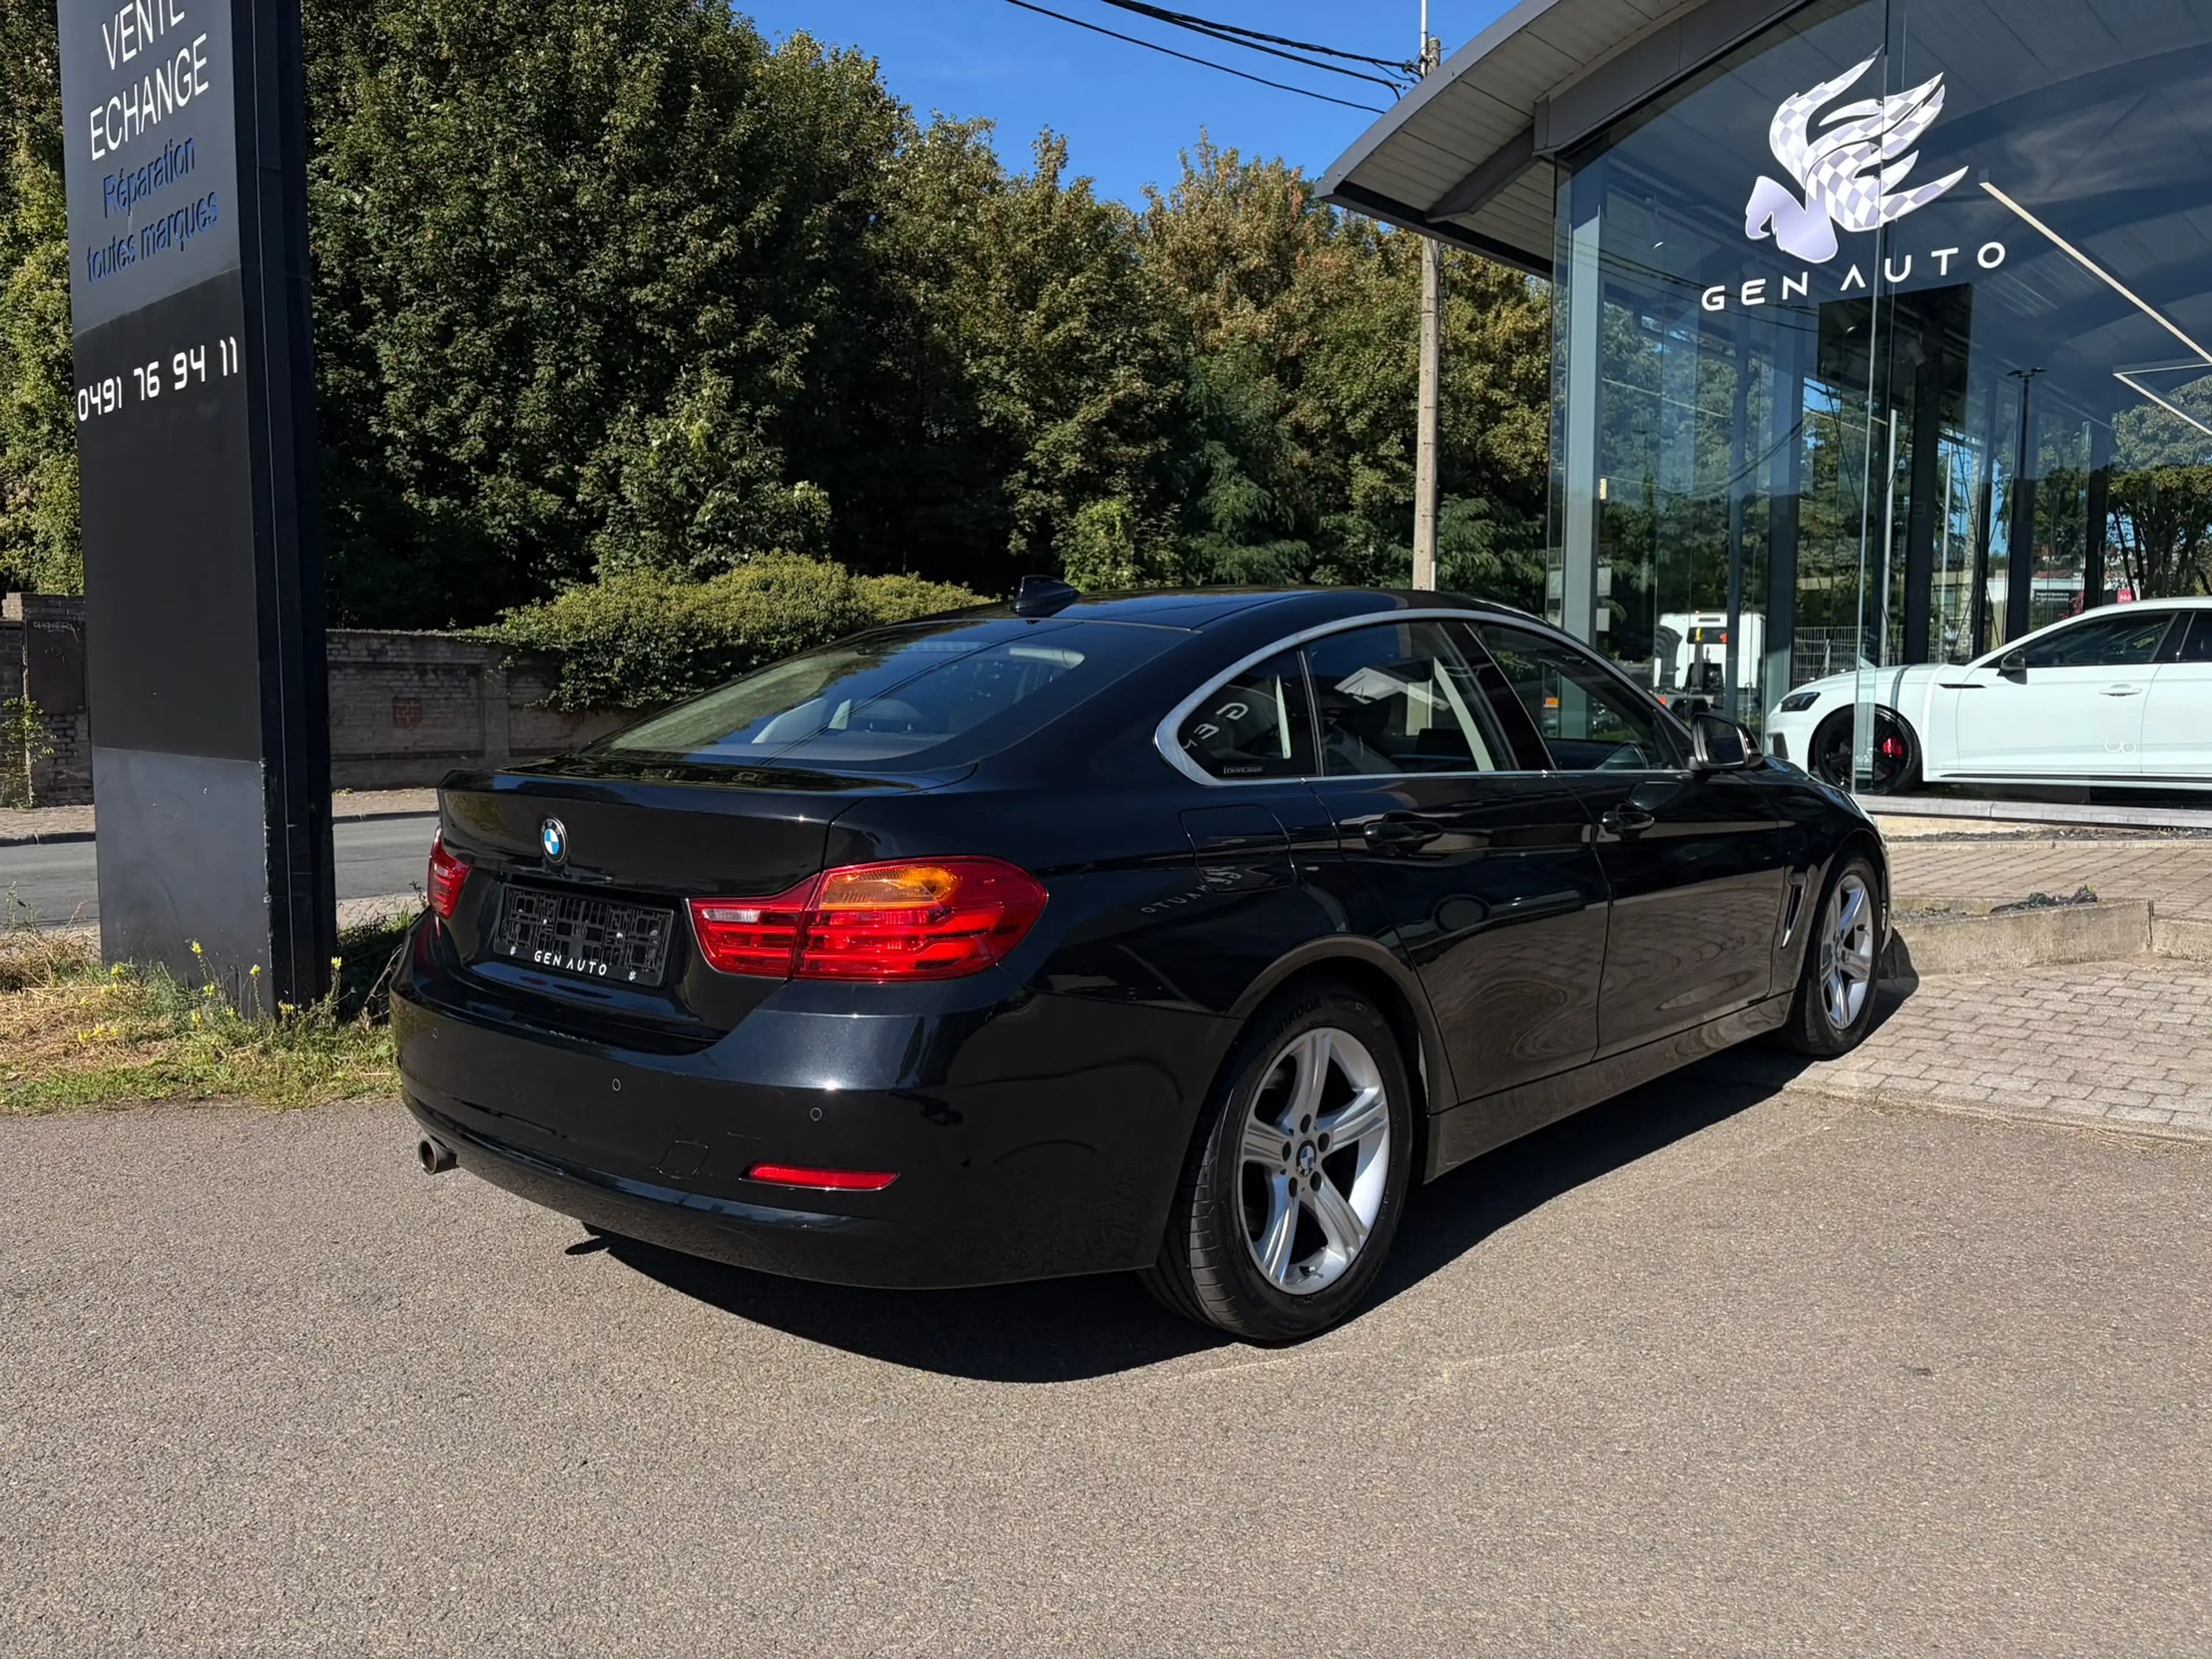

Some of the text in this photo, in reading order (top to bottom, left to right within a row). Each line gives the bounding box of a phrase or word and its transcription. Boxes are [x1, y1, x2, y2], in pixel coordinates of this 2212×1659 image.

[90, 33, 209, 161] ECHANGE
[103, 138, 196, 218] Réparation
[87, 191, 219, 283] toutes marques
[1702, 242, 2006, 311] GEN AUTO
[78, 336, 237, 421] 0491 76 94 11
[534, 950, 607, 976] GEN AUTO
